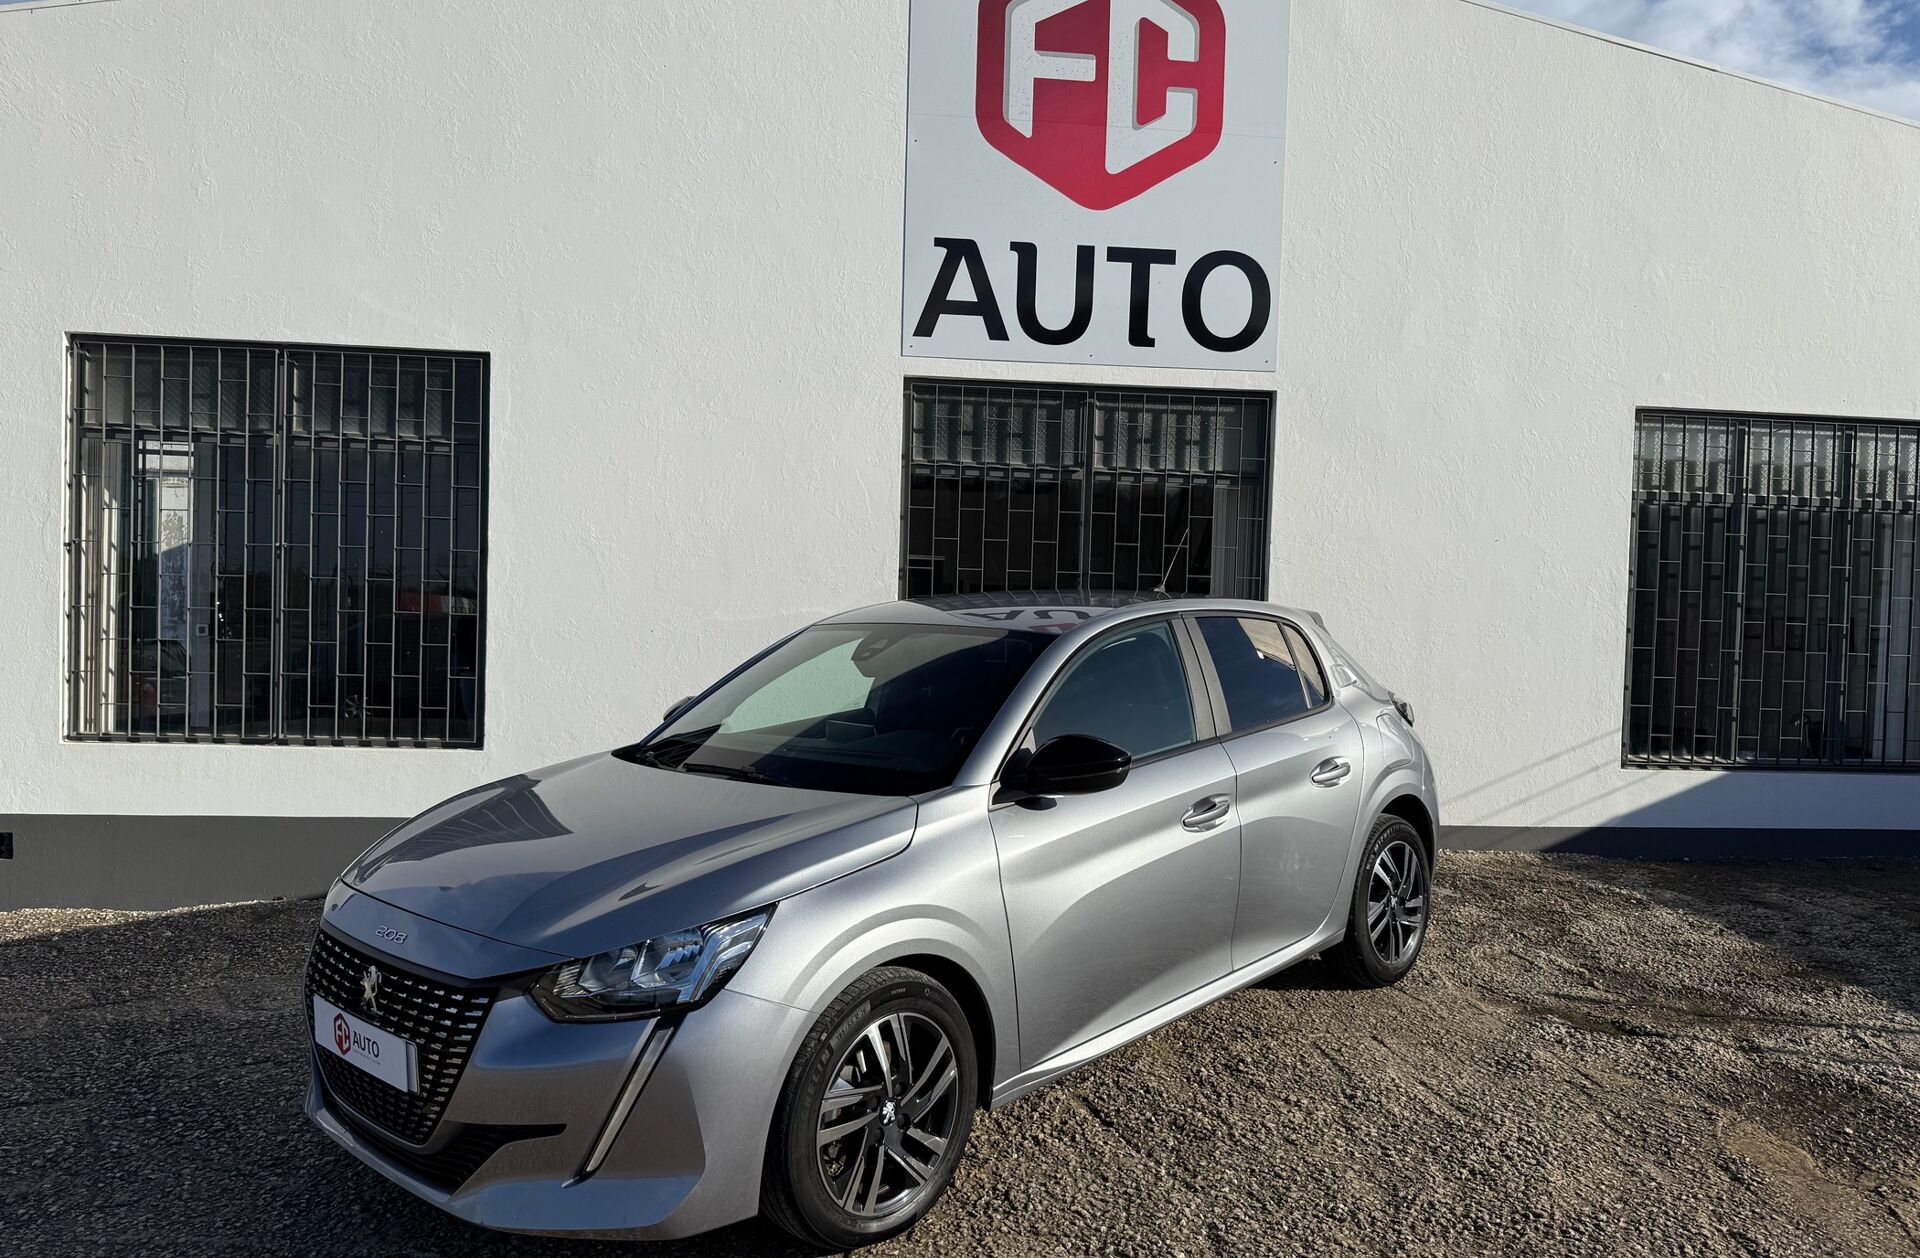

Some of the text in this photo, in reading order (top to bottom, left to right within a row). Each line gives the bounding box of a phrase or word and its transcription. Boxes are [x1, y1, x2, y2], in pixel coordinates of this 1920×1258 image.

[912, 237, 1271, 353] AUTO
[375, 925, 407, 943] 208
[353, 1031, 380, 1057] AUTO
